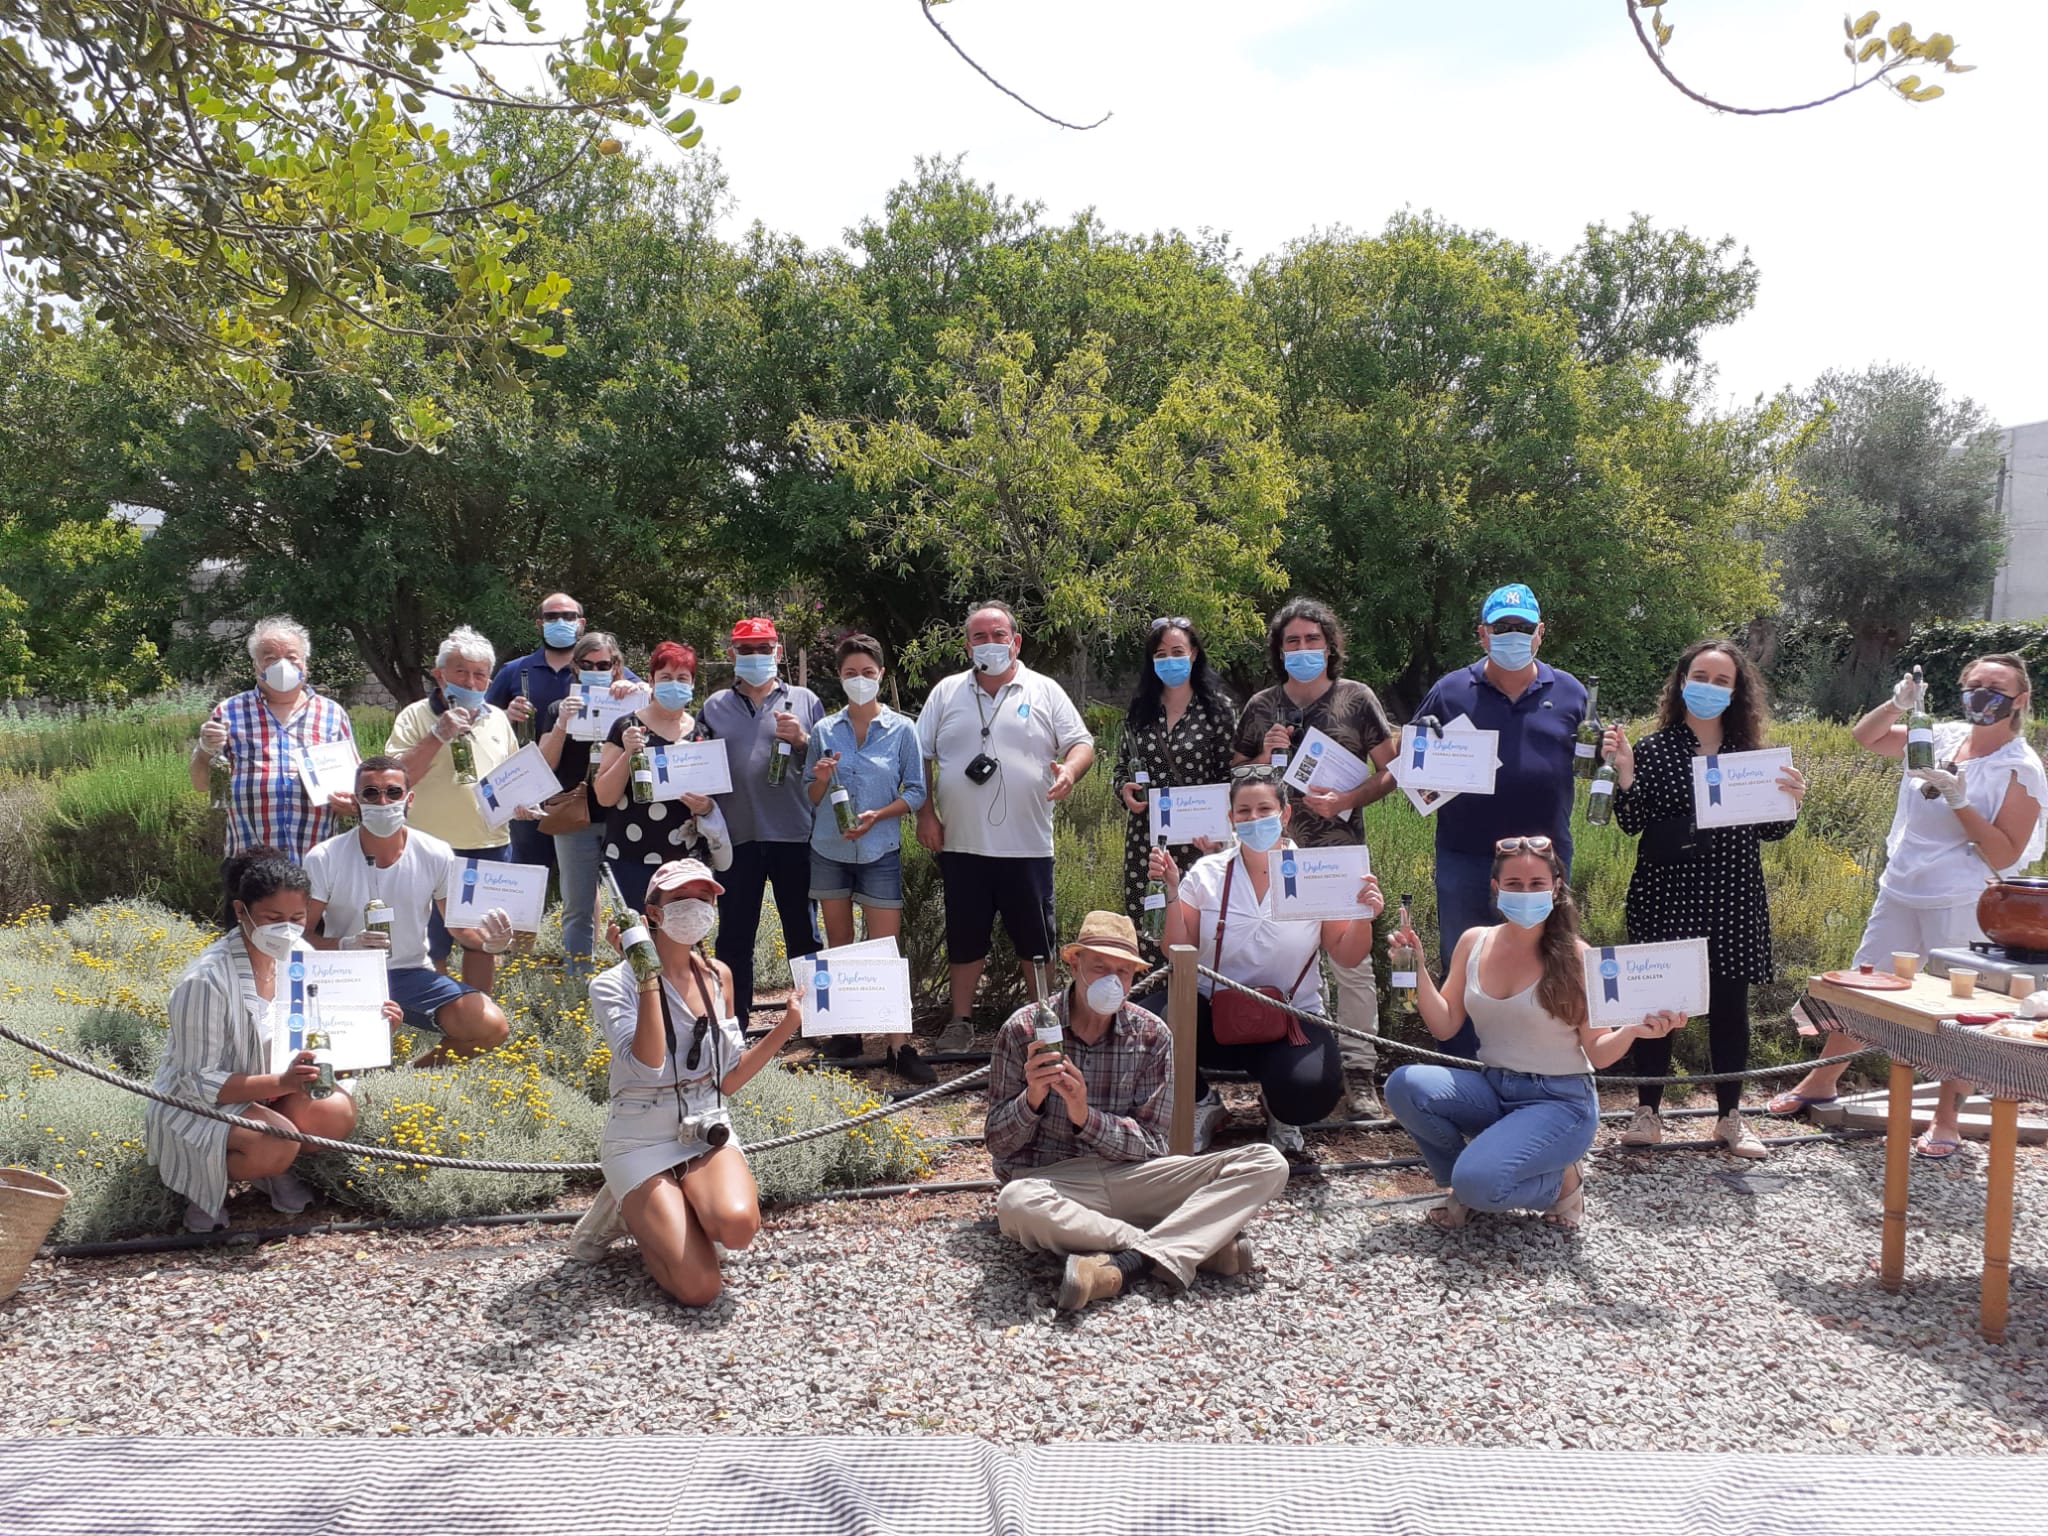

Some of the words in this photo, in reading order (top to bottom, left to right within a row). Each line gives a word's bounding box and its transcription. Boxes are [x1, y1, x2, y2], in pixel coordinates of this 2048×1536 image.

[1433, 739, 1469, 751] Diploma
[1727, 767, 1764, 781] Diploma
[1176, 795, 1207, 807] Diploma
[1303, 860, 1339, 873] Diploma
[484, 872, 518, 885] Diploma
[311, 963, 353, 978] Diploma
[1626, 958, 1672, 973] Diploma
[838, 971, 878, 985] Diploma
